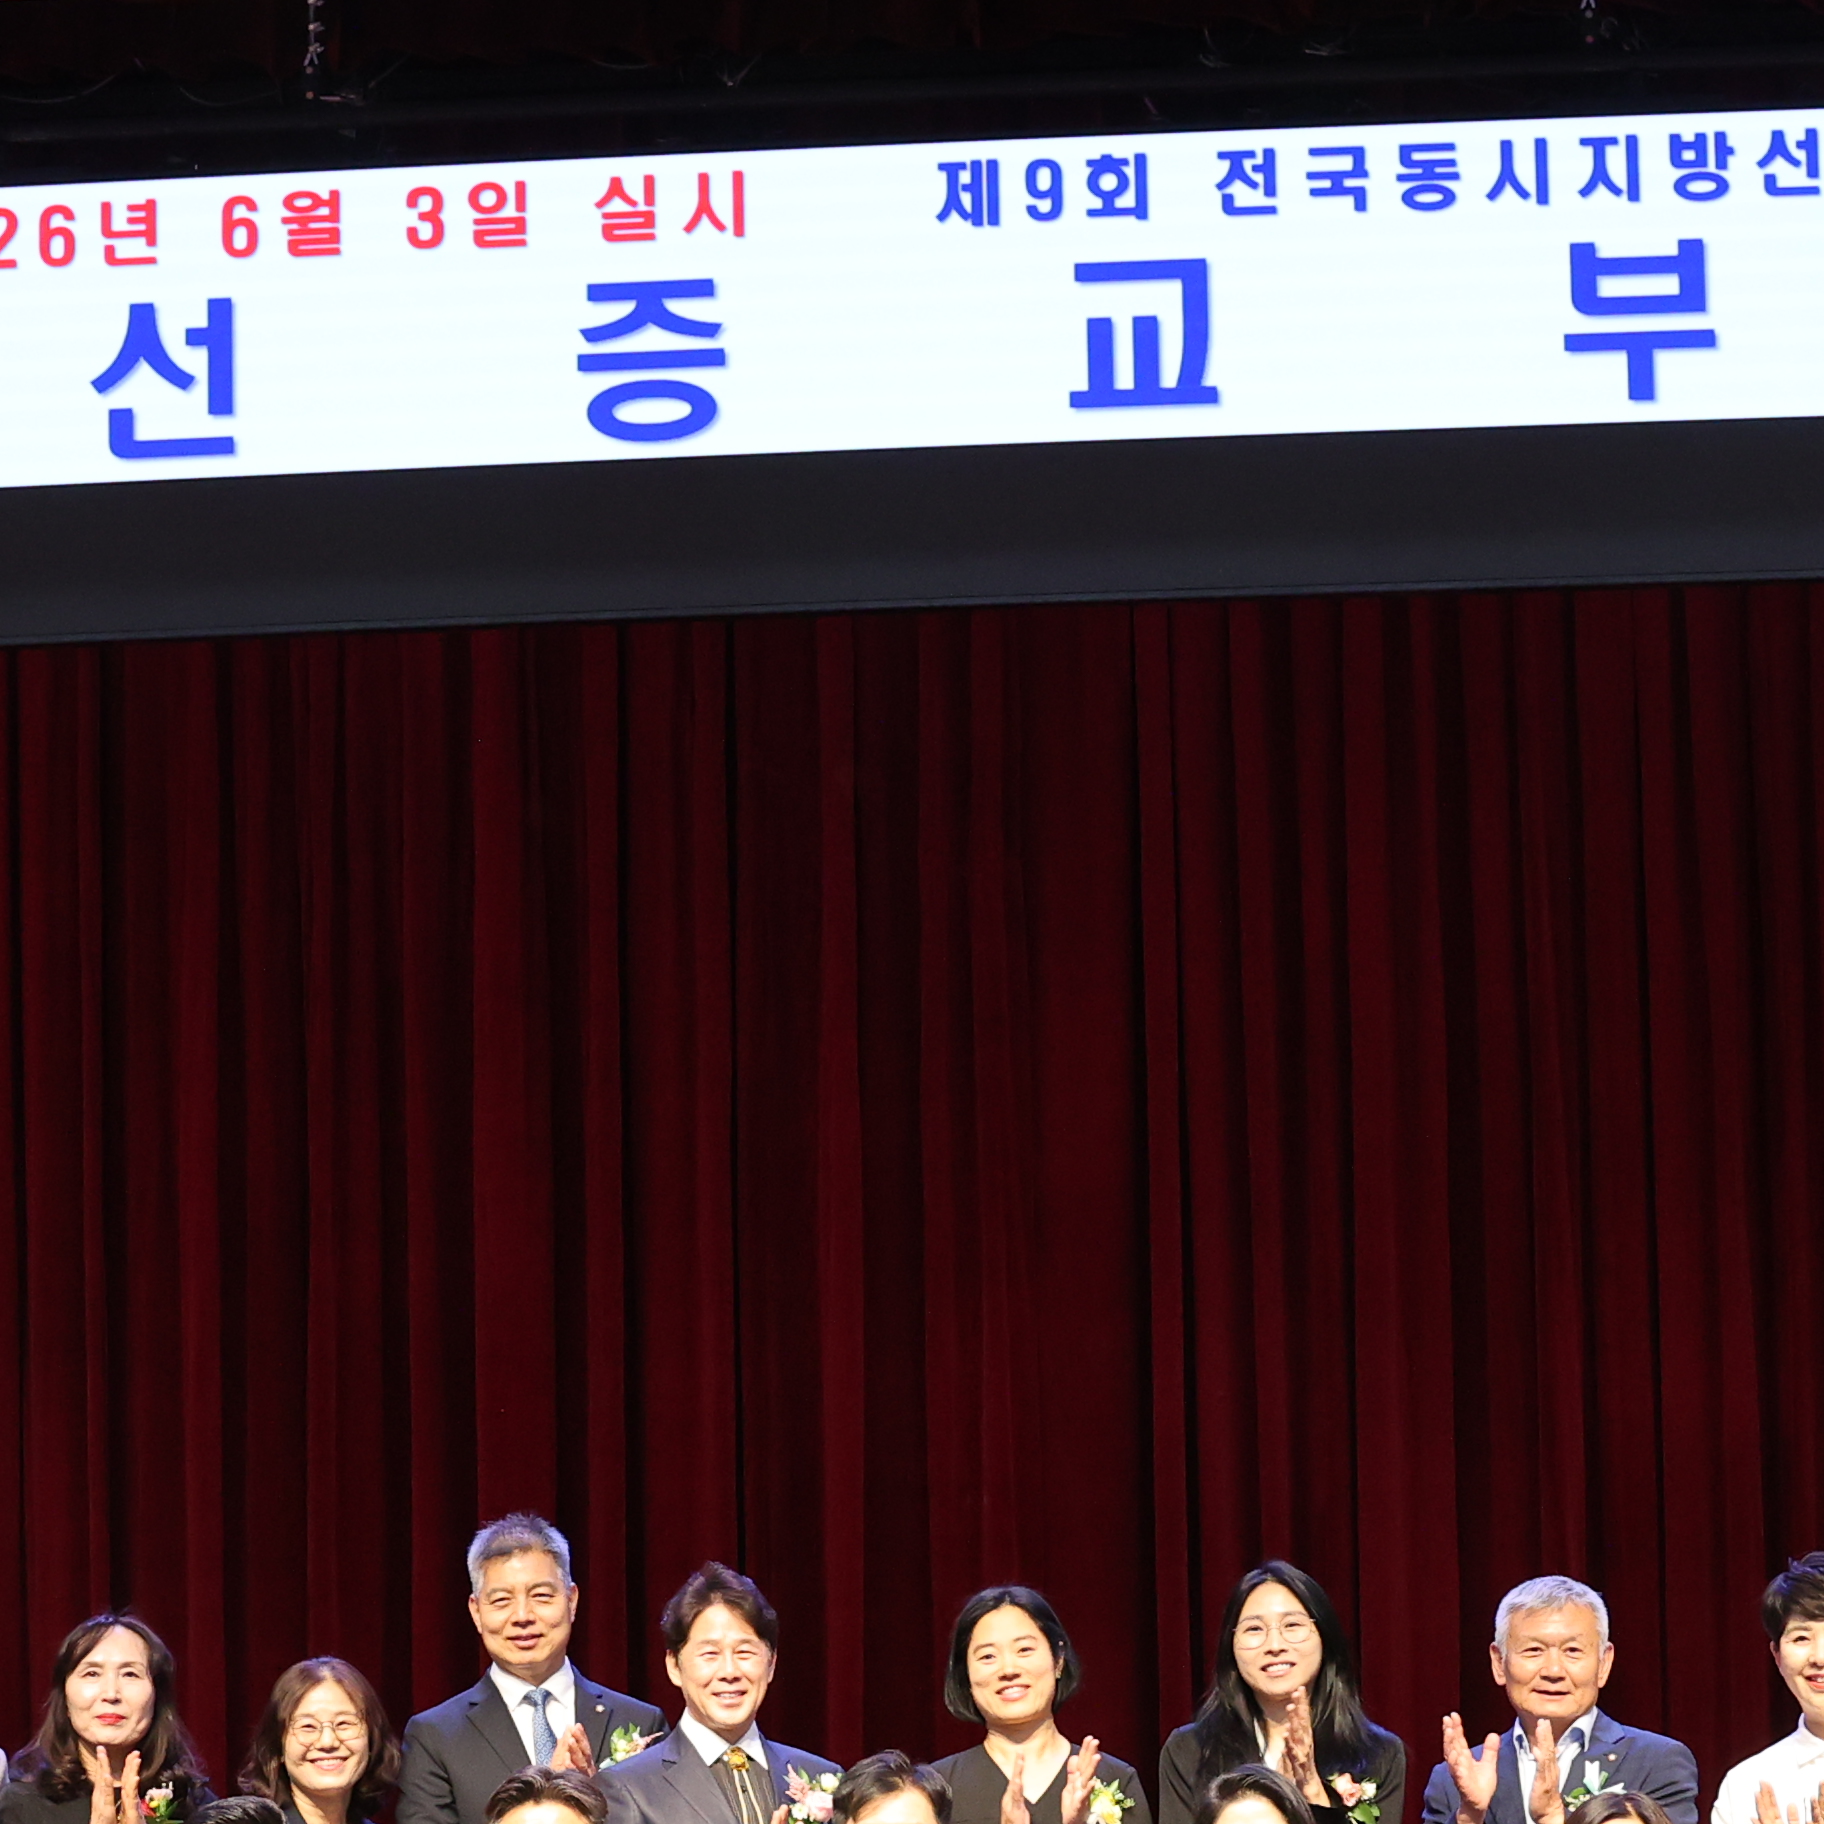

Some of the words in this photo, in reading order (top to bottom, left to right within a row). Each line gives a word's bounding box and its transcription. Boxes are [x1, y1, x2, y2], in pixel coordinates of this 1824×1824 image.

[220, 188, 343, 259] 6월
[405, 179, 529, 250] 3일
[593, 169, 746, 243] 실시
[934, 151, 1150, 228] 제9회
